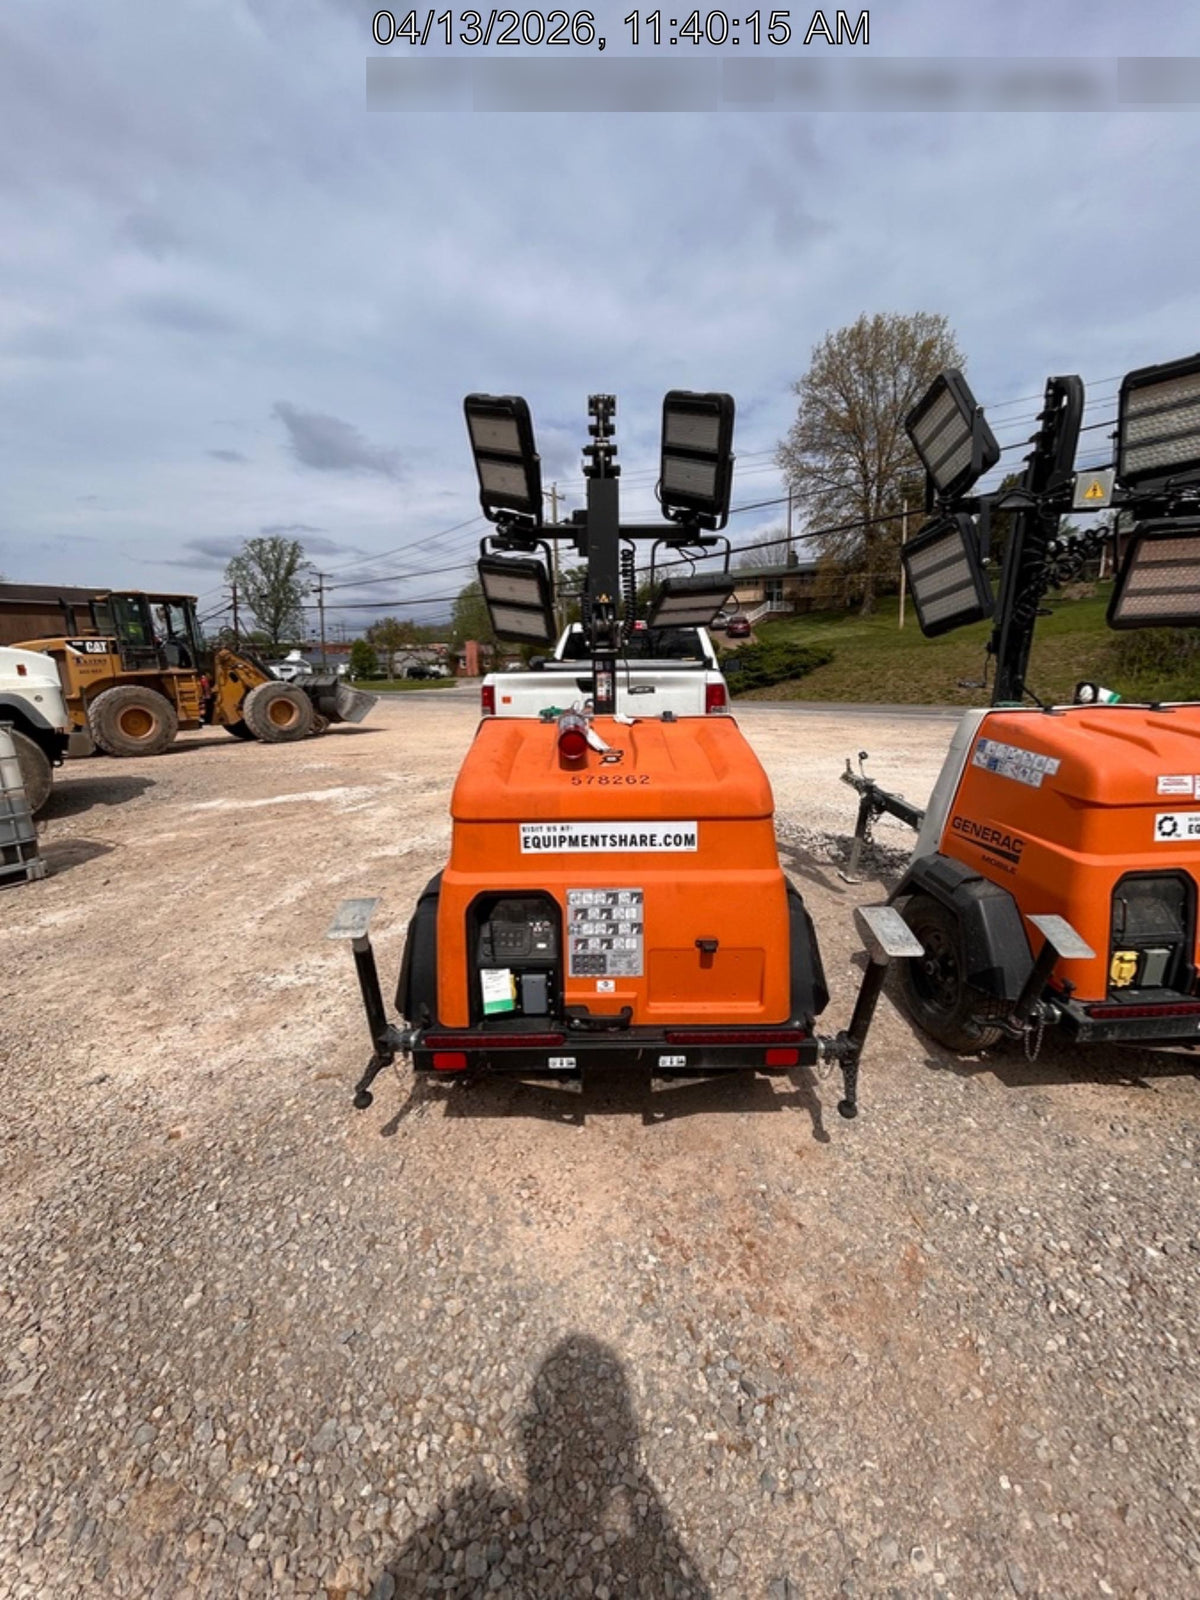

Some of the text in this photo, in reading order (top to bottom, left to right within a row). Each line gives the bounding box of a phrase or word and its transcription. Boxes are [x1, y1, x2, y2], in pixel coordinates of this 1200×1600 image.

[85, 641, 107, 653] CAT
[571, 775, 650, 786] 578262
[522, 833, 696, 849] EQUIPMENTSHARE.COM
[952, 816, 1025, 854] GENERAC
